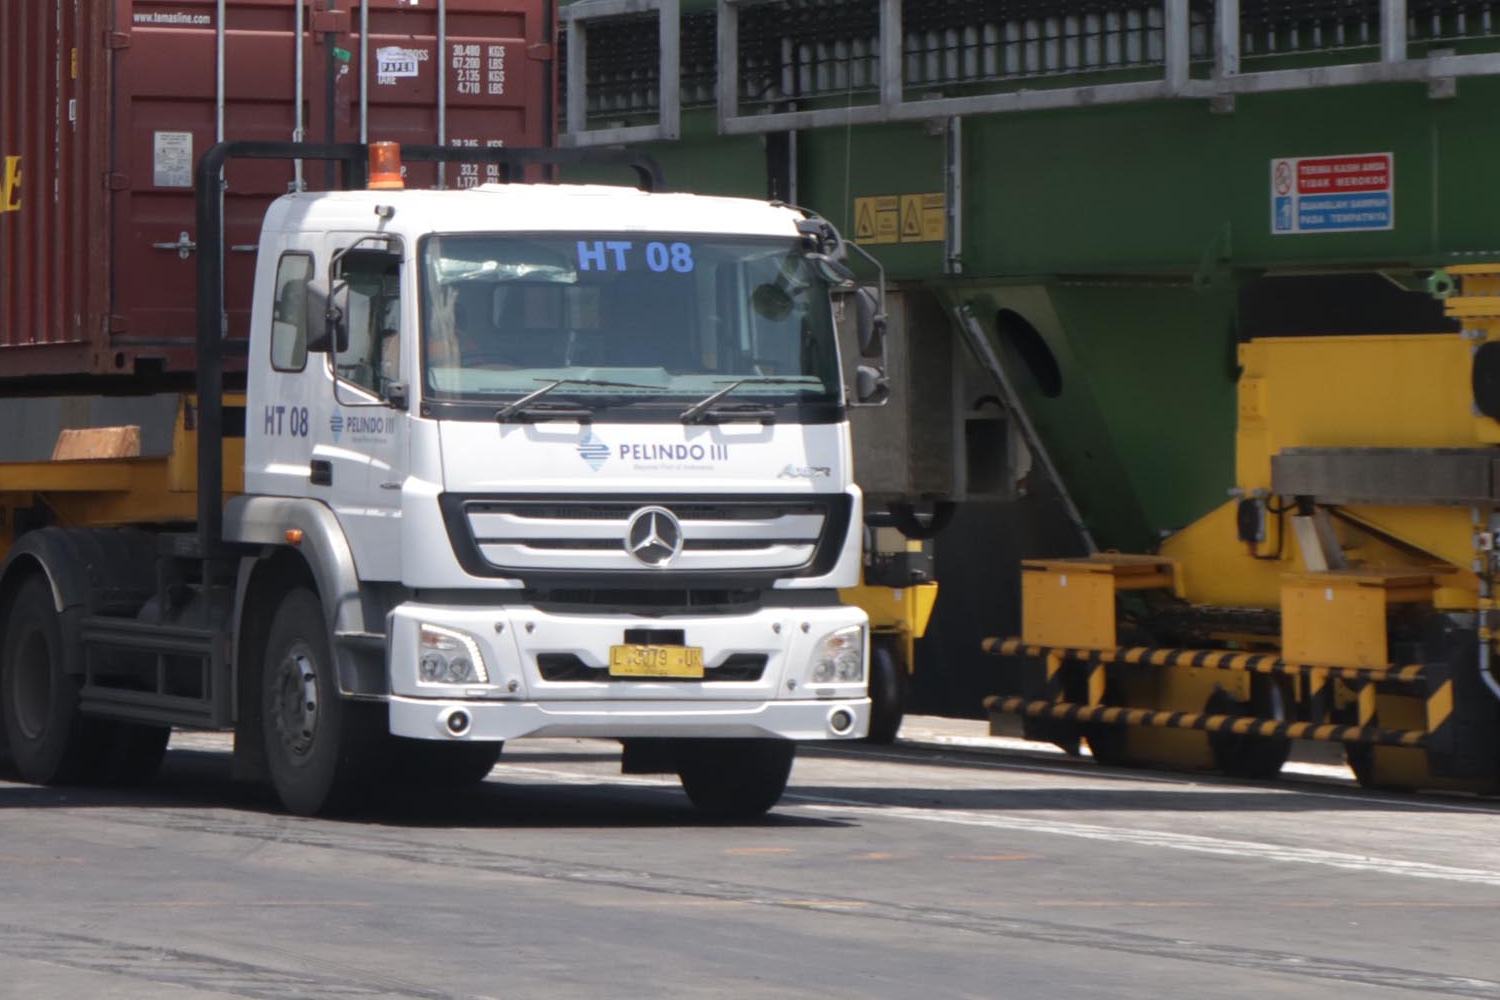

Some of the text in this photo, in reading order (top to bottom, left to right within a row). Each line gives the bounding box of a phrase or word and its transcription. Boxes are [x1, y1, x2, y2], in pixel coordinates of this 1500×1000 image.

[488, 46, 505, 58] KGS
[488, 58, 504, 70] LBS
[488, 71, 505, 83] KGS
[488, 83, 504, 95] LBS
[576, 241, 695, 273] HT 08
[264, 405, 309, 438] HT 08
[346, 416, 384, 434] PELINDO
[619, 444, 729, 461] PELINDO III
[613, 647, 622, 665] L
